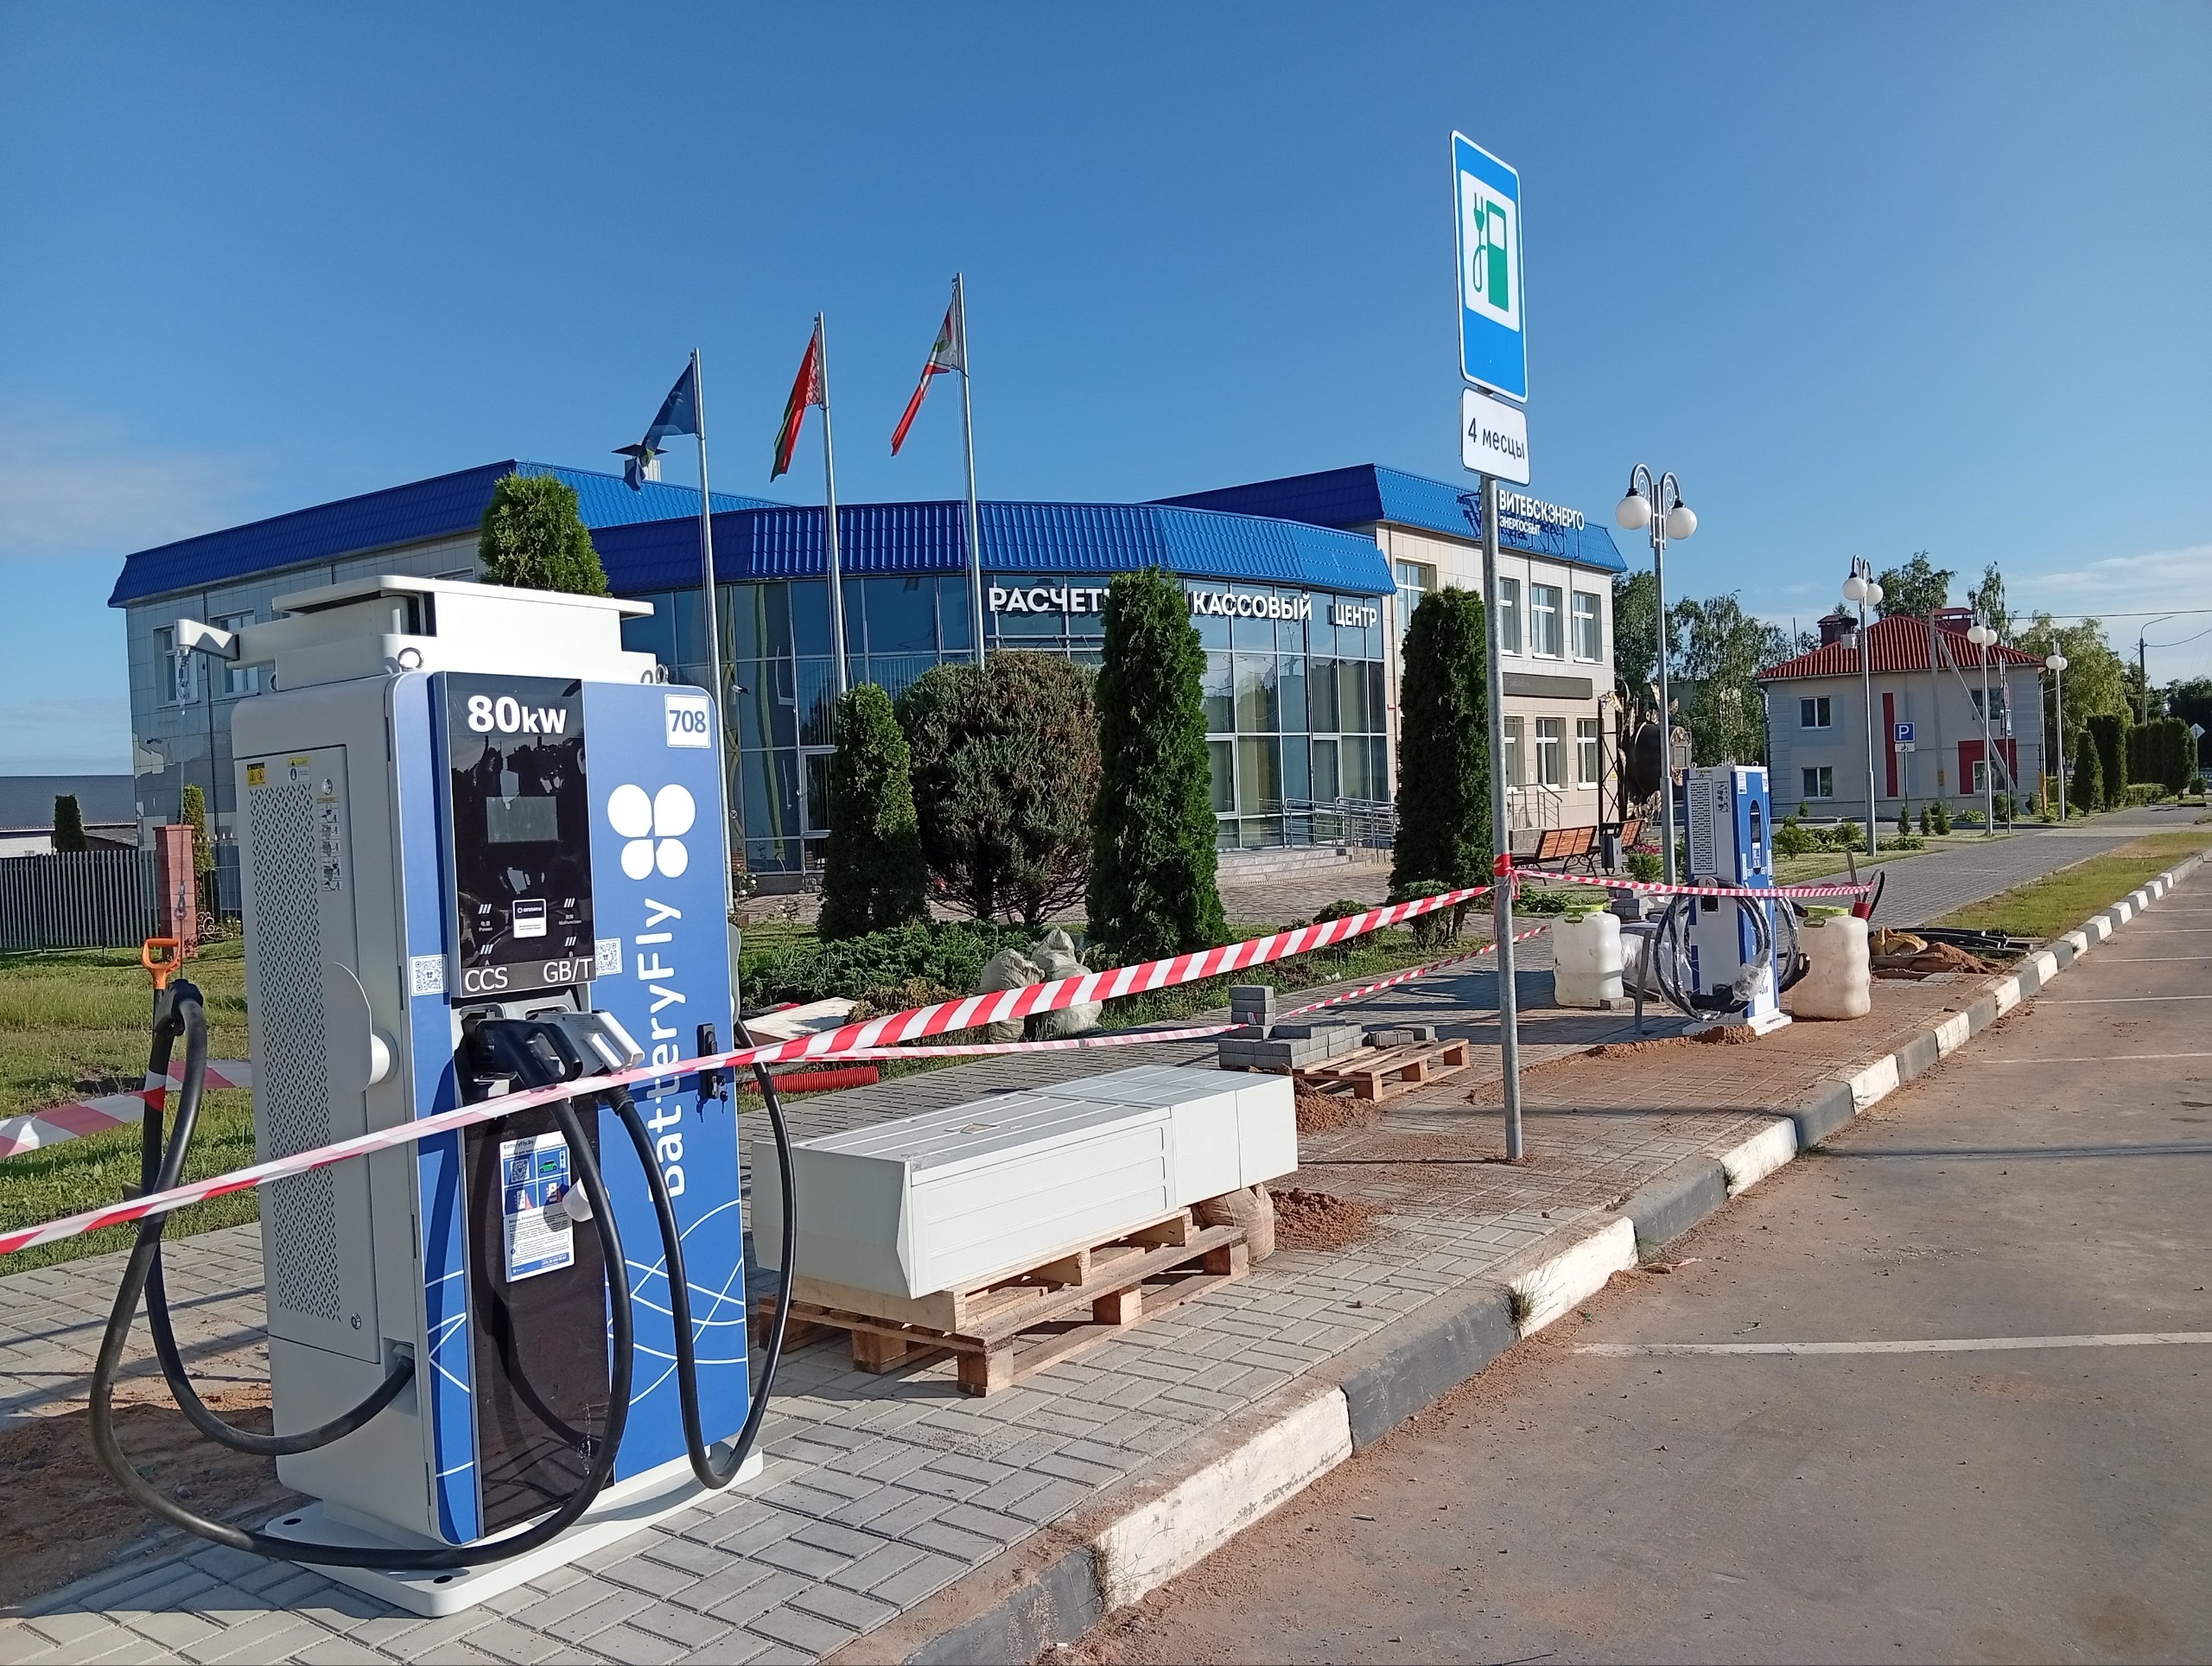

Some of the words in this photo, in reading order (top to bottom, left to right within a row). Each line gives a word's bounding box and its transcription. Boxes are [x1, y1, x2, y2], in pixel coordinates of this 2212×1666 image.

[1467, 417, 1478, 443] 4
[1483, 428, 1525, 460] месцы
[1498, 488, 1585, 531] ВИТЕБСКЭНЕРГО
[1499, 515, 1541, 537] ЭНЕРГОСБЫТ
[988, 587, 1111, 613] РАСЧЕТ
[1192, 591, 1313, 621] КАССОВЫЙ
[1334, 603, 1377, 628] ЦЕНТР
[467, 695, 567, 734] 80kW
[669, 709, 706, 734] 708
[1898, 724, 1910, 740] P
[464, 967, 509, 992] CCS
[543, 958, 593, 983] GB/T
